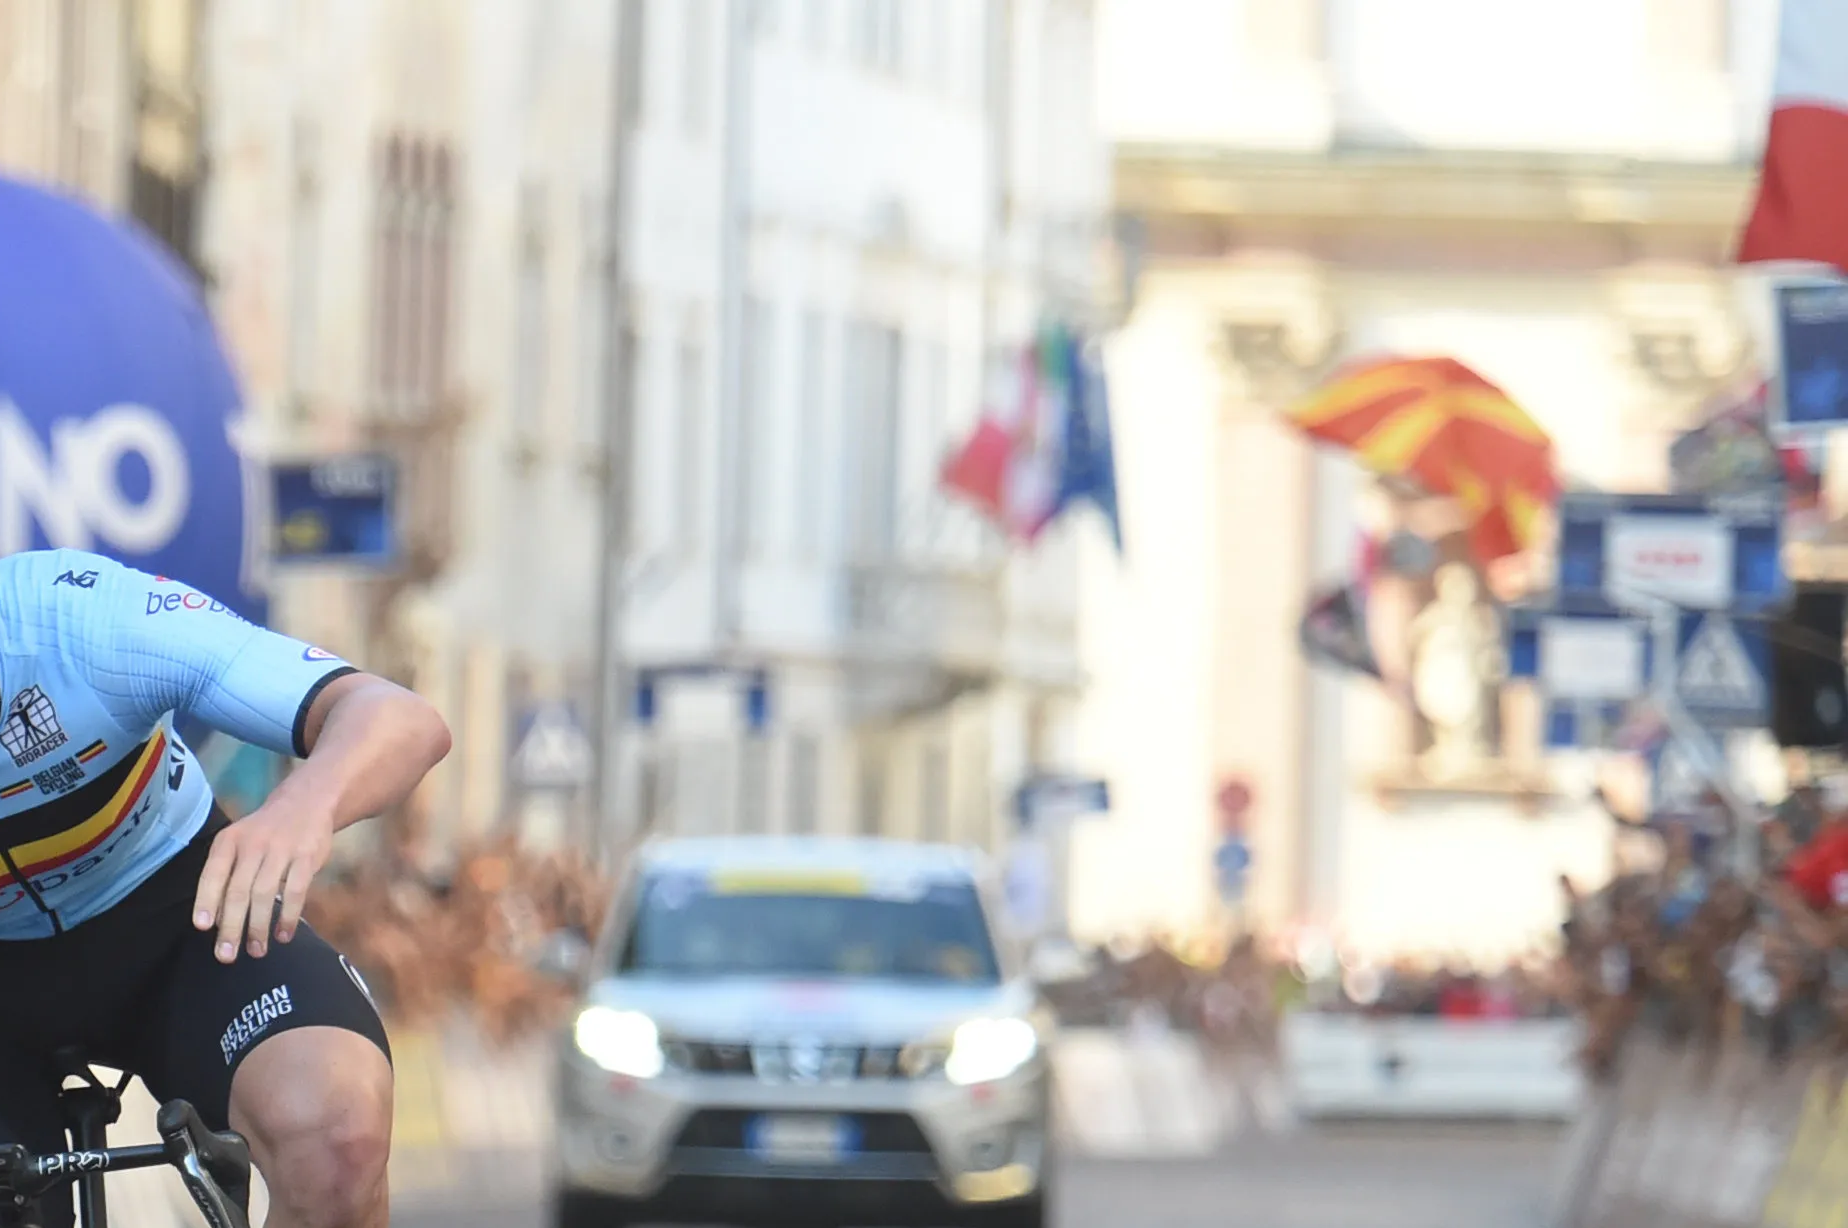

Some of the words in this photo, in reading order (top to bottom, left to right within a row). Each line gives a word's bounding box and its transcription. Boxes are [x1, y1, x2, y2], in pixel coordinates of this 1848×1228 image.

[15, 732, 69, 768] BIORACER
[33, 756, 78, 786] BELGIAN
[39, 767, 86, 796] CYCLING
[220, 984, 289, 1053] BELGIAN
[224, 999, 293, 1066] CYCLING
